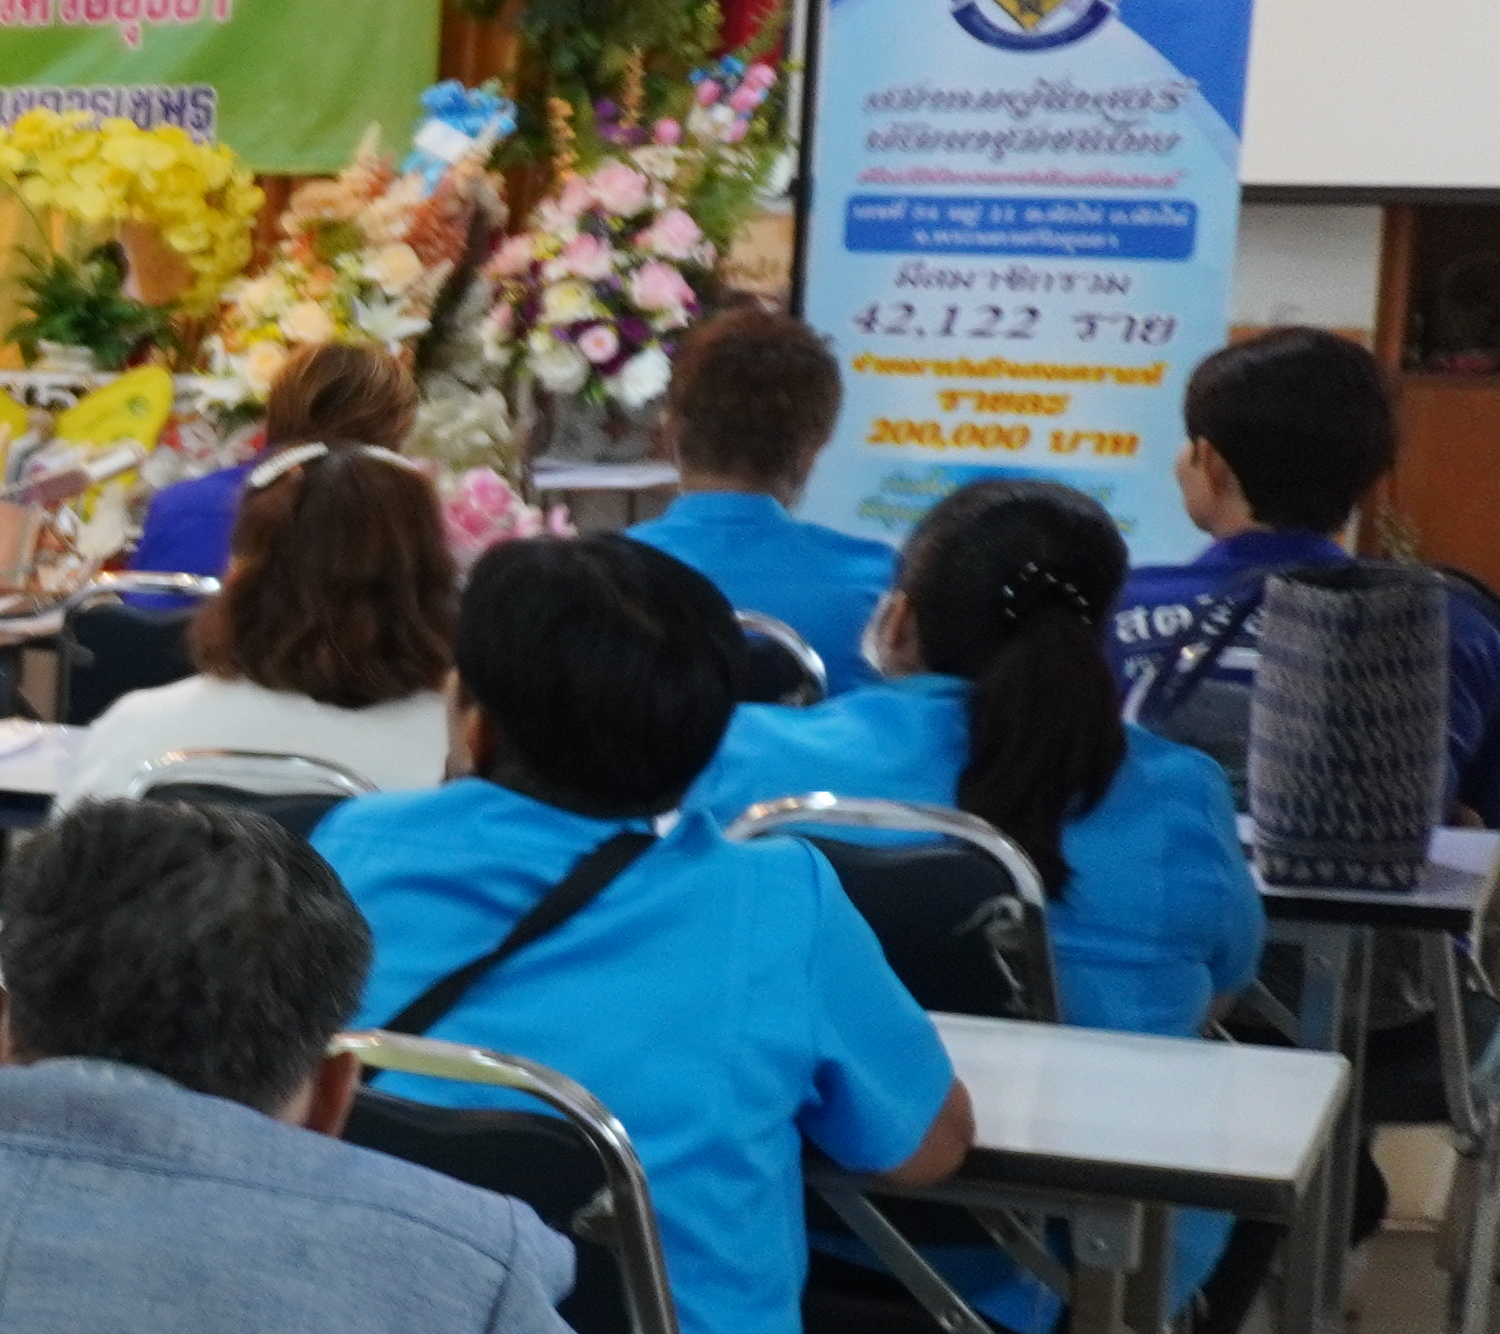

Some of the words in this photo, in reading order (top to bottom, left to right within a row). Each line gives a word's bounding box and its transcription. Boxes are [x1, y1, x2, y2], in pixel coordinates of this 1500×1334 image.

[855, 302, 1042, 342] 42,122
[1072, 310, 1179, 346] ราย
[864, 418, 1031, 452] 200,000
